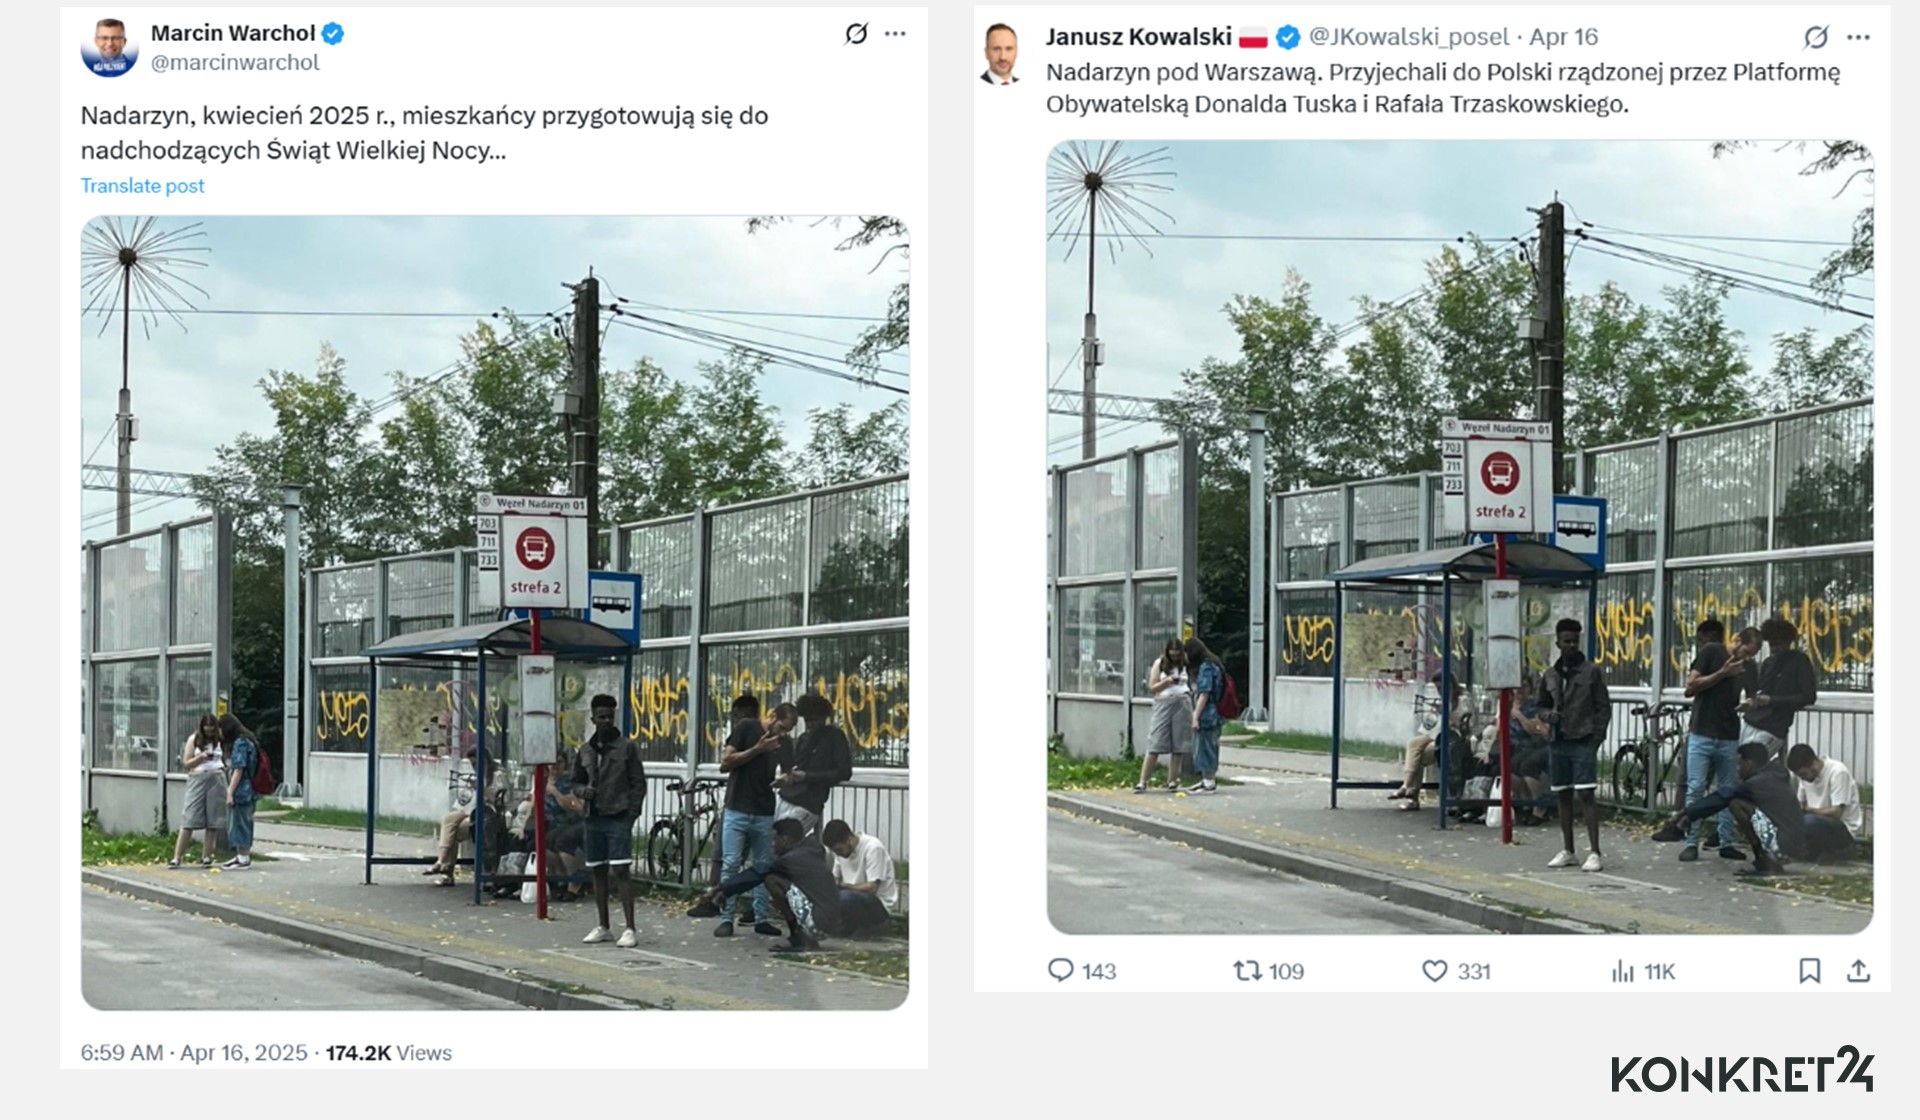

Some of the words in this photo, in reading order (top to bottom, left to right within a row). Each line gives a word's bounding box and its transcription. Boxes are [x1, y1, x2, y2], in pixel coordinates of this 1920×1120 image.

[1463, 422, 1490, 434] Węzeł
[1494, 424, 1535, 436] Nadarzyn
[1538, 425, 1550, 434] 01
[1445, 442, 1461, 452] 703
[1446, 461, 1461, 471] 711
[1445, 479, 1462, 489] 733
[497, 498, 525, 511] Węzeł
[528, 499, 570, 512] Nadarzyn
[573, 500, 584, 510] 01
[1476, 505, 1514, 518] strefa
[1519, 506, 1526, 518] 2
[479, 518, 496, 528] 703
[481, 537, 495, 547] 711
[481, 555, 497, 565] 733
[511, 580, 549, 593] strefa
[553, 581, 561, 594] 2
